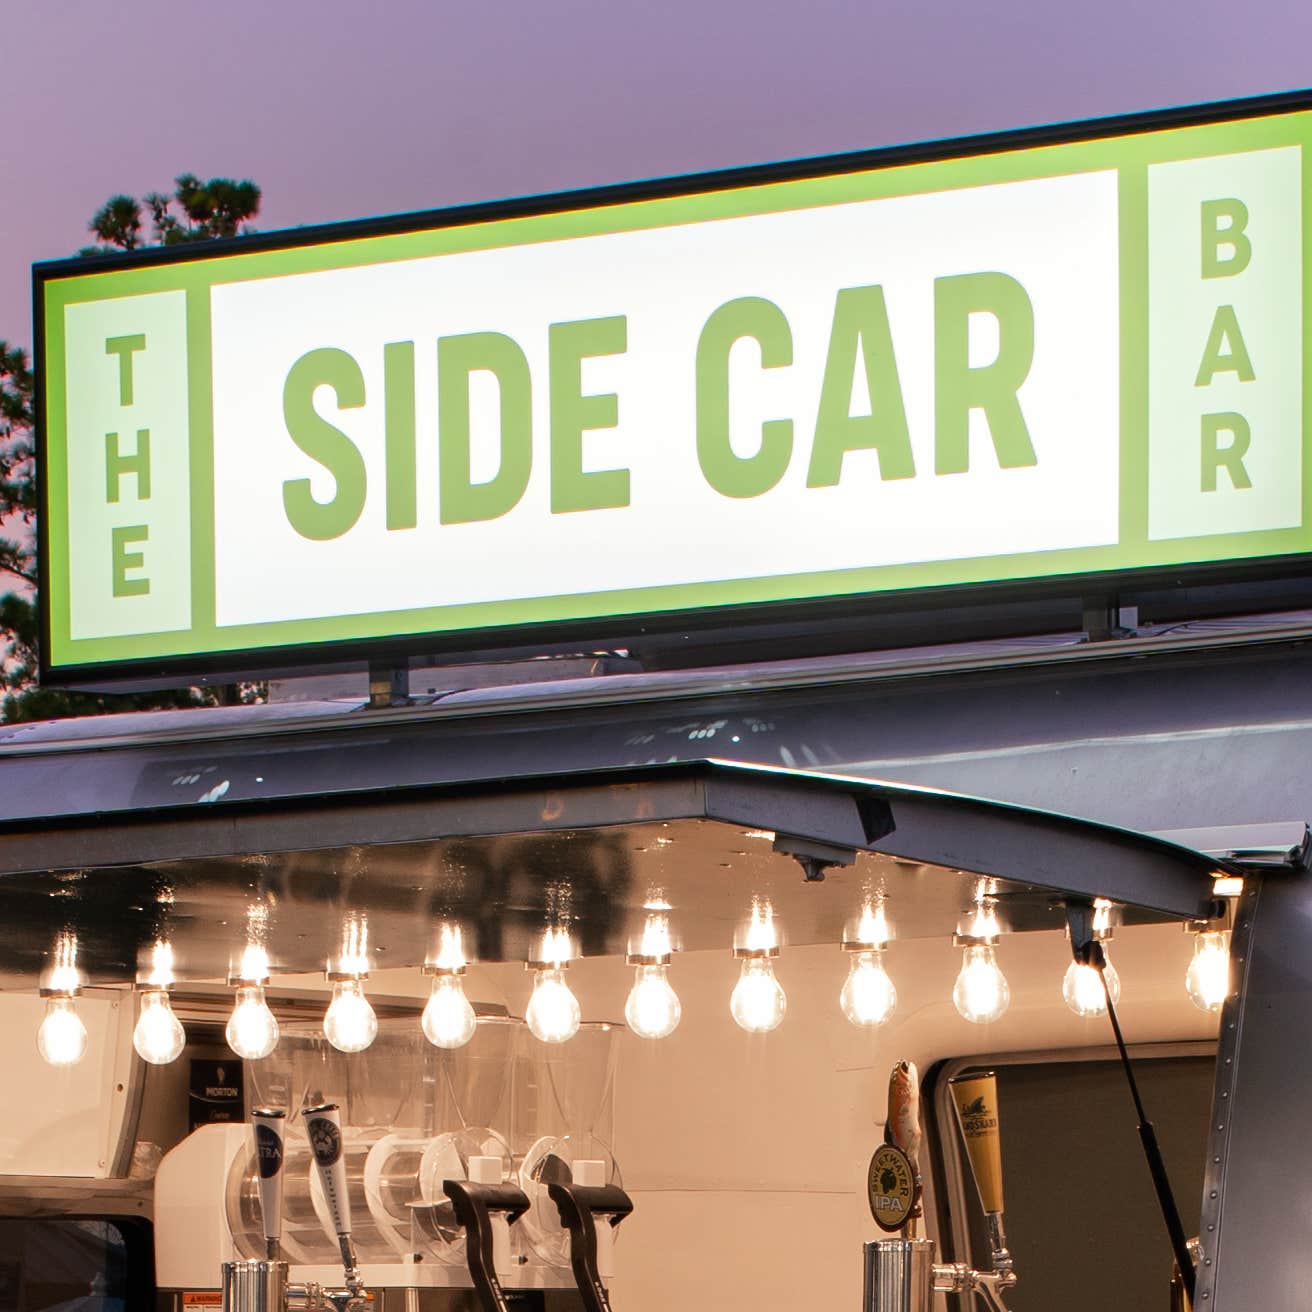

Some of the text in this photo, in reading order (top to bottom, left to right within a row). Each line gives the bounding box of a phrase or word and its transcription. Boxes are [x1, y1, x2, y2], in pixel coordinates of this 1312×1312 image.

[104, 332, 153, 598] THE
[281, 270, 1039, 541] SIDE CAR
[1193, 196, 1257, 494] BAR
[874, 1194, 904, 1213] IPA
